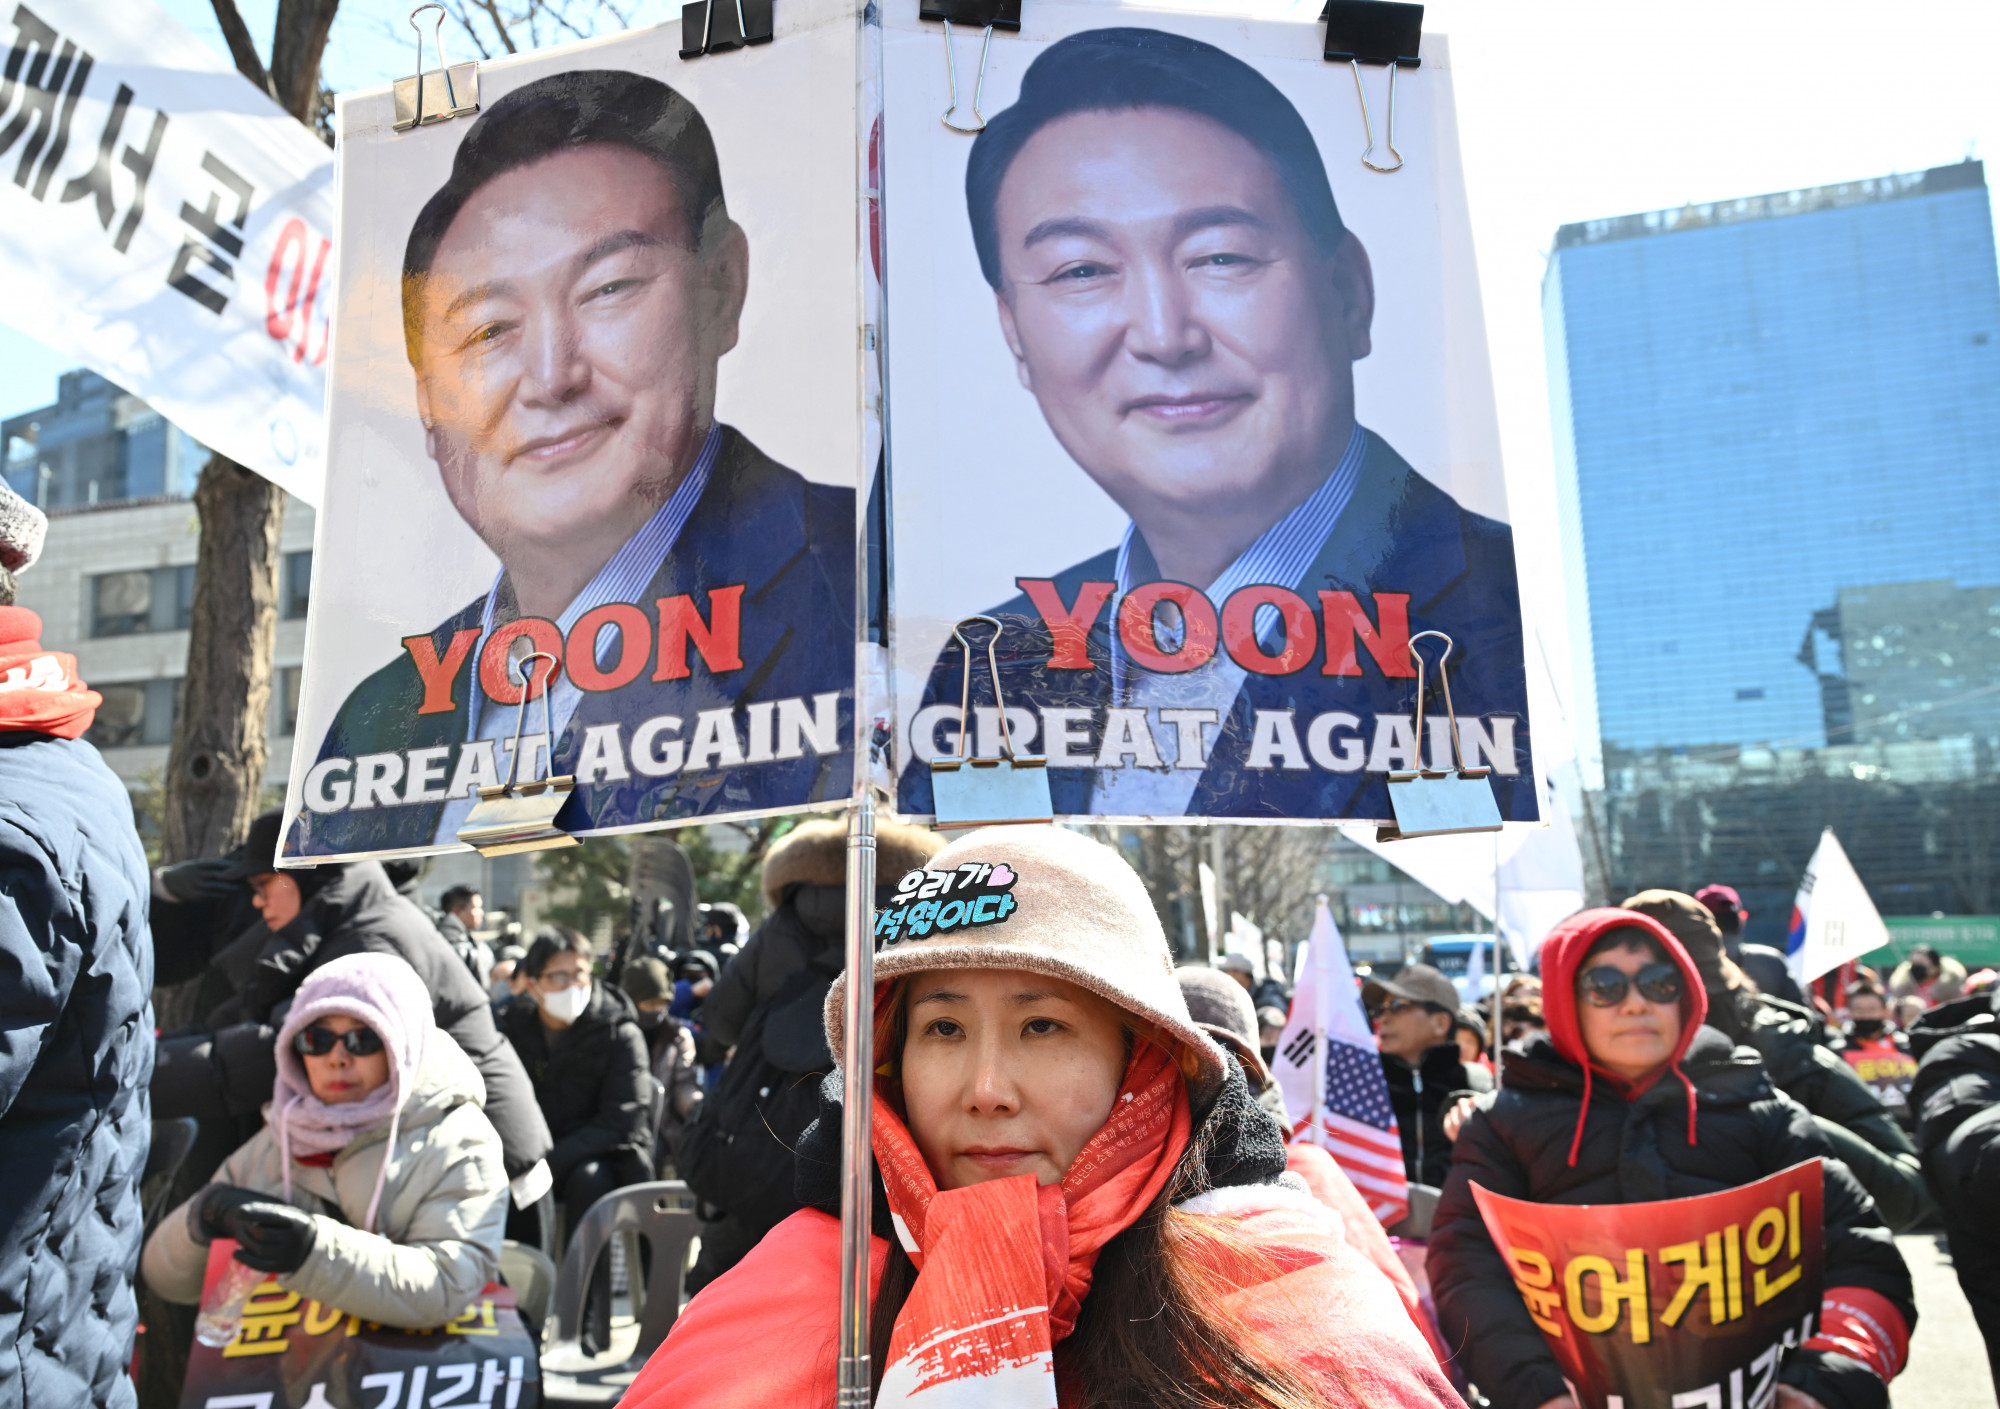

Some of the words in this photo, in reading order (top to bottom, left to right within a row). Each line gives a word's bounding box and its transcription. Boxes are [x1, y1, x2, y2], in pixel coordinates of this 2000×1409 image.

[167, 150, 255, 316] 곧
[402, 585, 745, 714] YOON
[1015, 577, 1418, 678] YOON
[303, 734, 550, 813] GREAT
[576, 693, 841, 783] AGAIN
[909, 704, 1219, 770] GREAT
[1244, 709, 1520, 776] AGAIN
[875, 894, 1015, 940] 석열이다
[891, 863, 992, 905] 우리가
[1090, 1127, 1117, 1150] 탄핵과
[1118, 1117, 1136, 1132] 특검
[900, 1173, 923, 1200] 운명에
[1070, 1161, 1098, 1186] 집단의
[1507, 1191, 1803, 1344] 윤어게인
